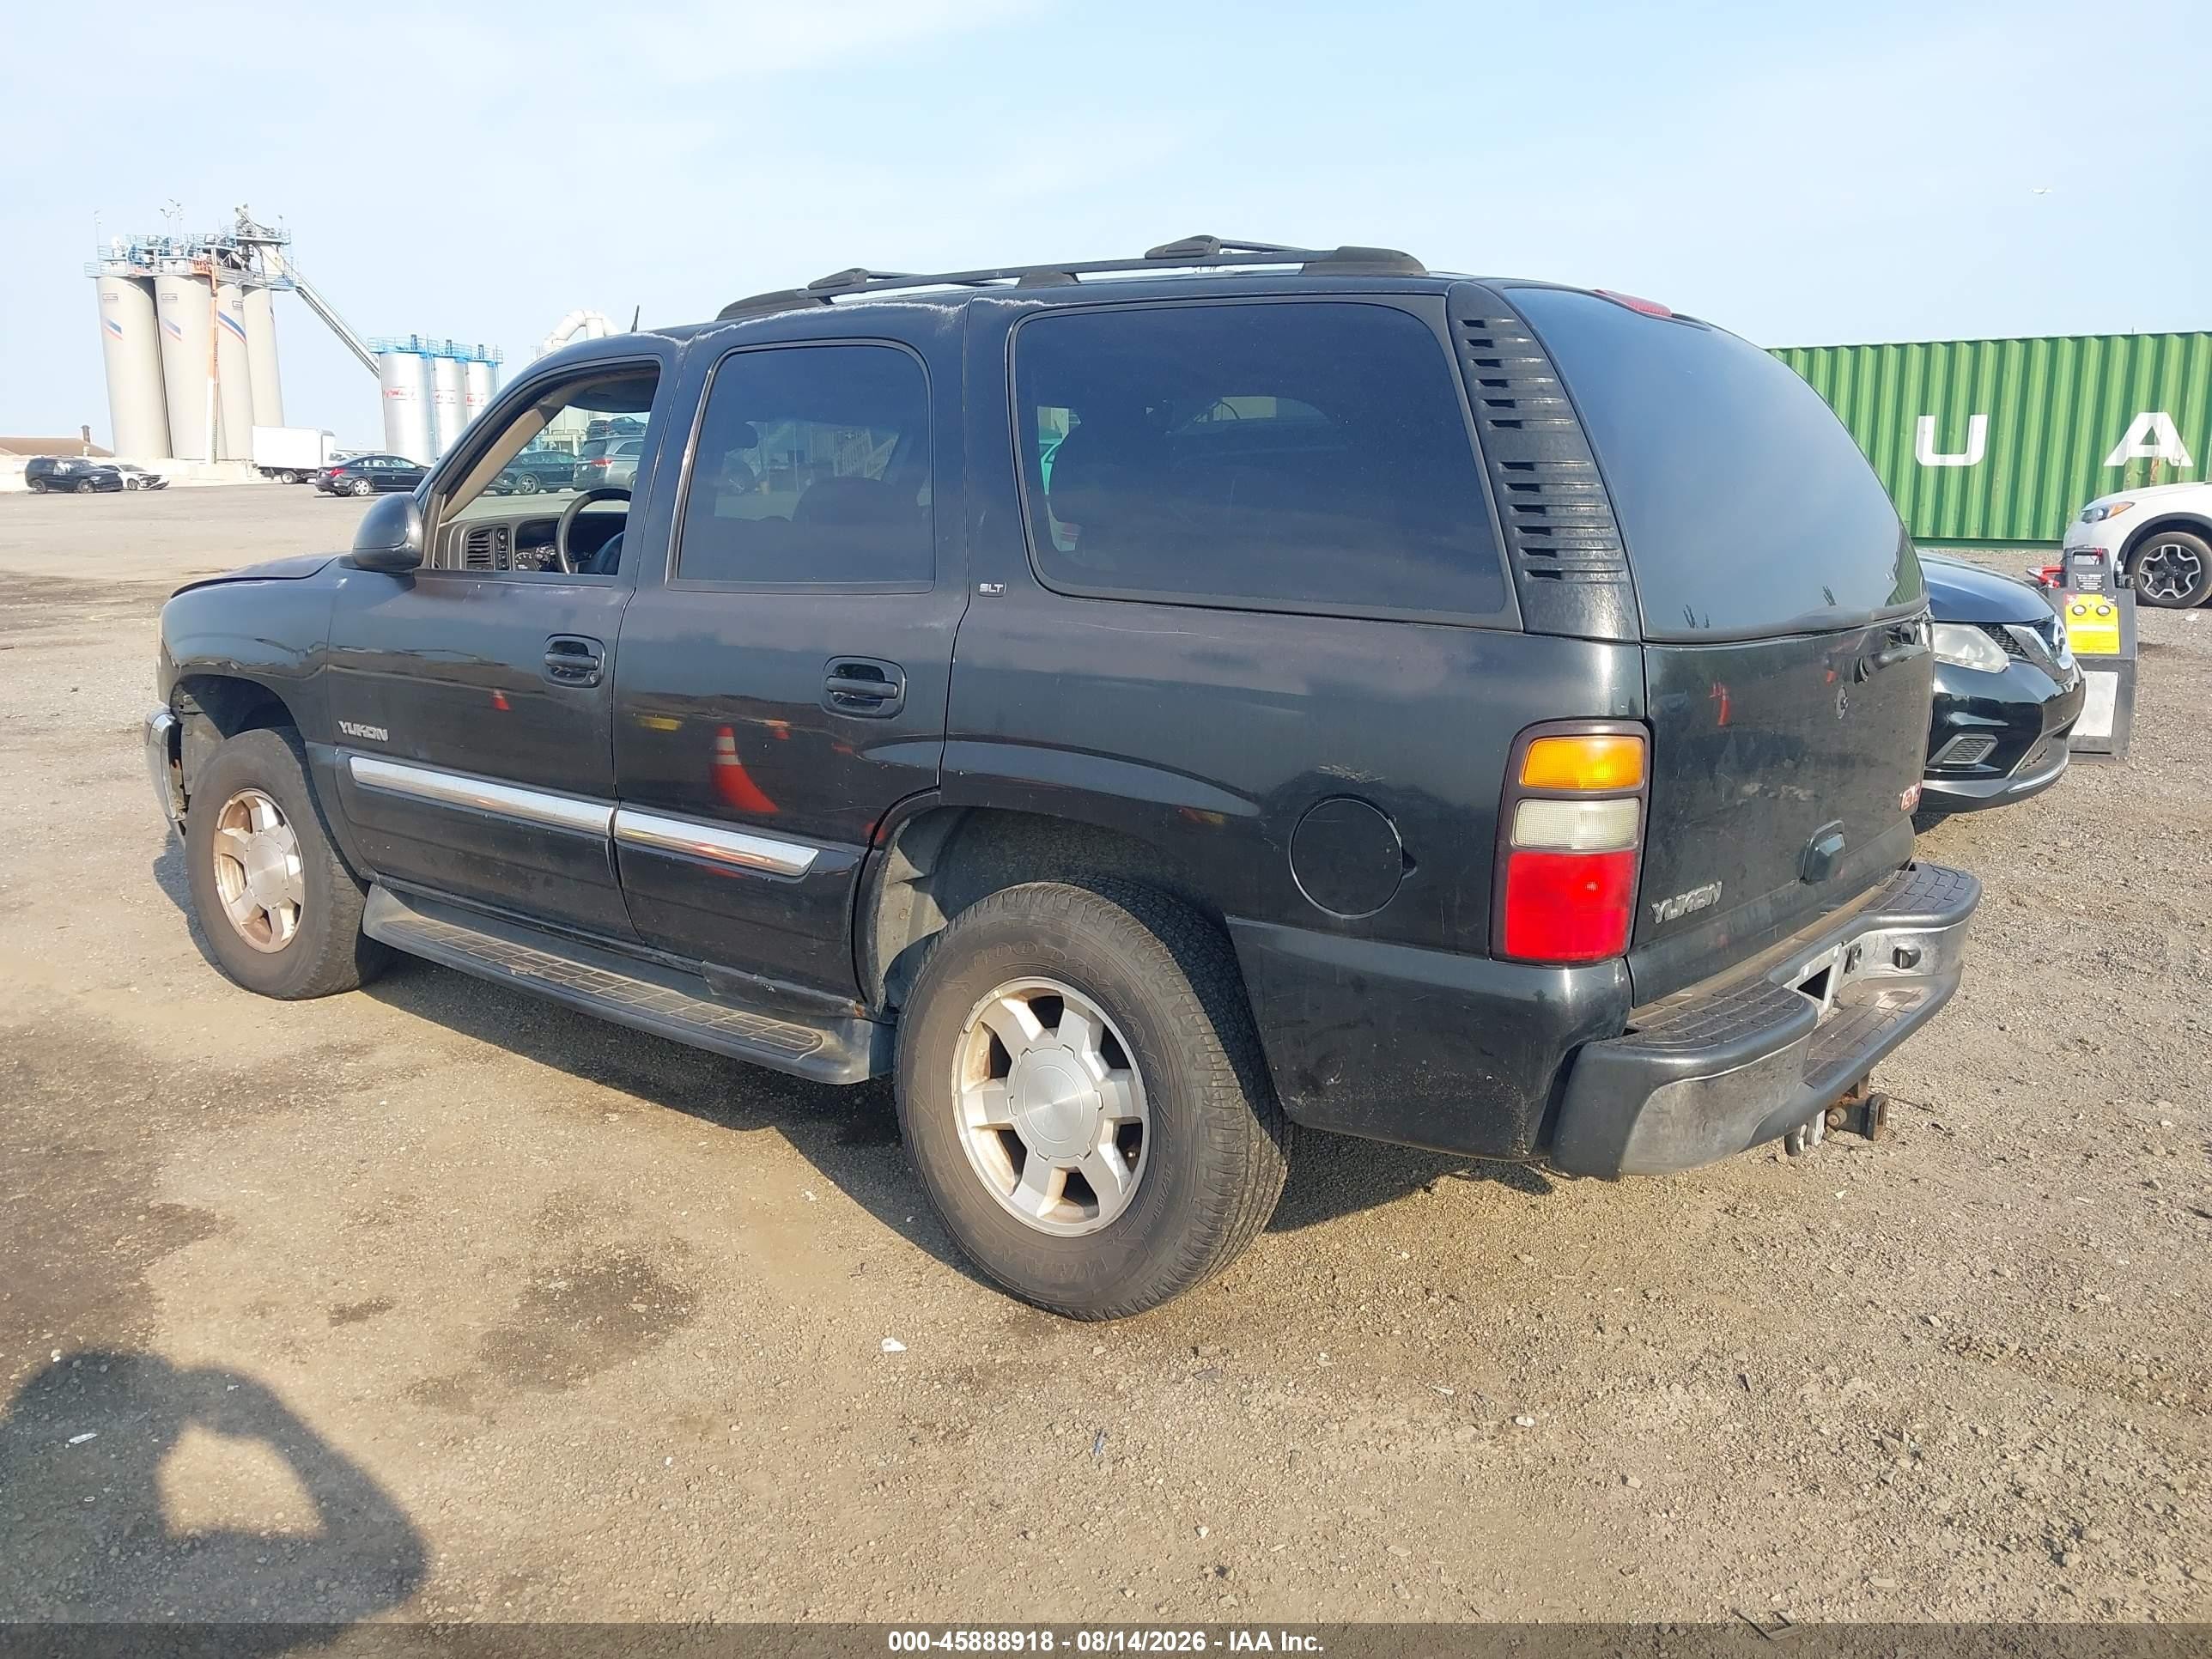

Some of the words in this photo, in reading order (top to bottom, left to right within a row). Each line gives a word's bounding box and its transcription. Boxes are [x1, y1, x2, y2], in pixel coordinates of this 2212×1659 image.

[979, 583, 1004, 592] SLT
[337, 720, 389, 742] YUKON
[1651, 880, 1723, 924] YUKON
